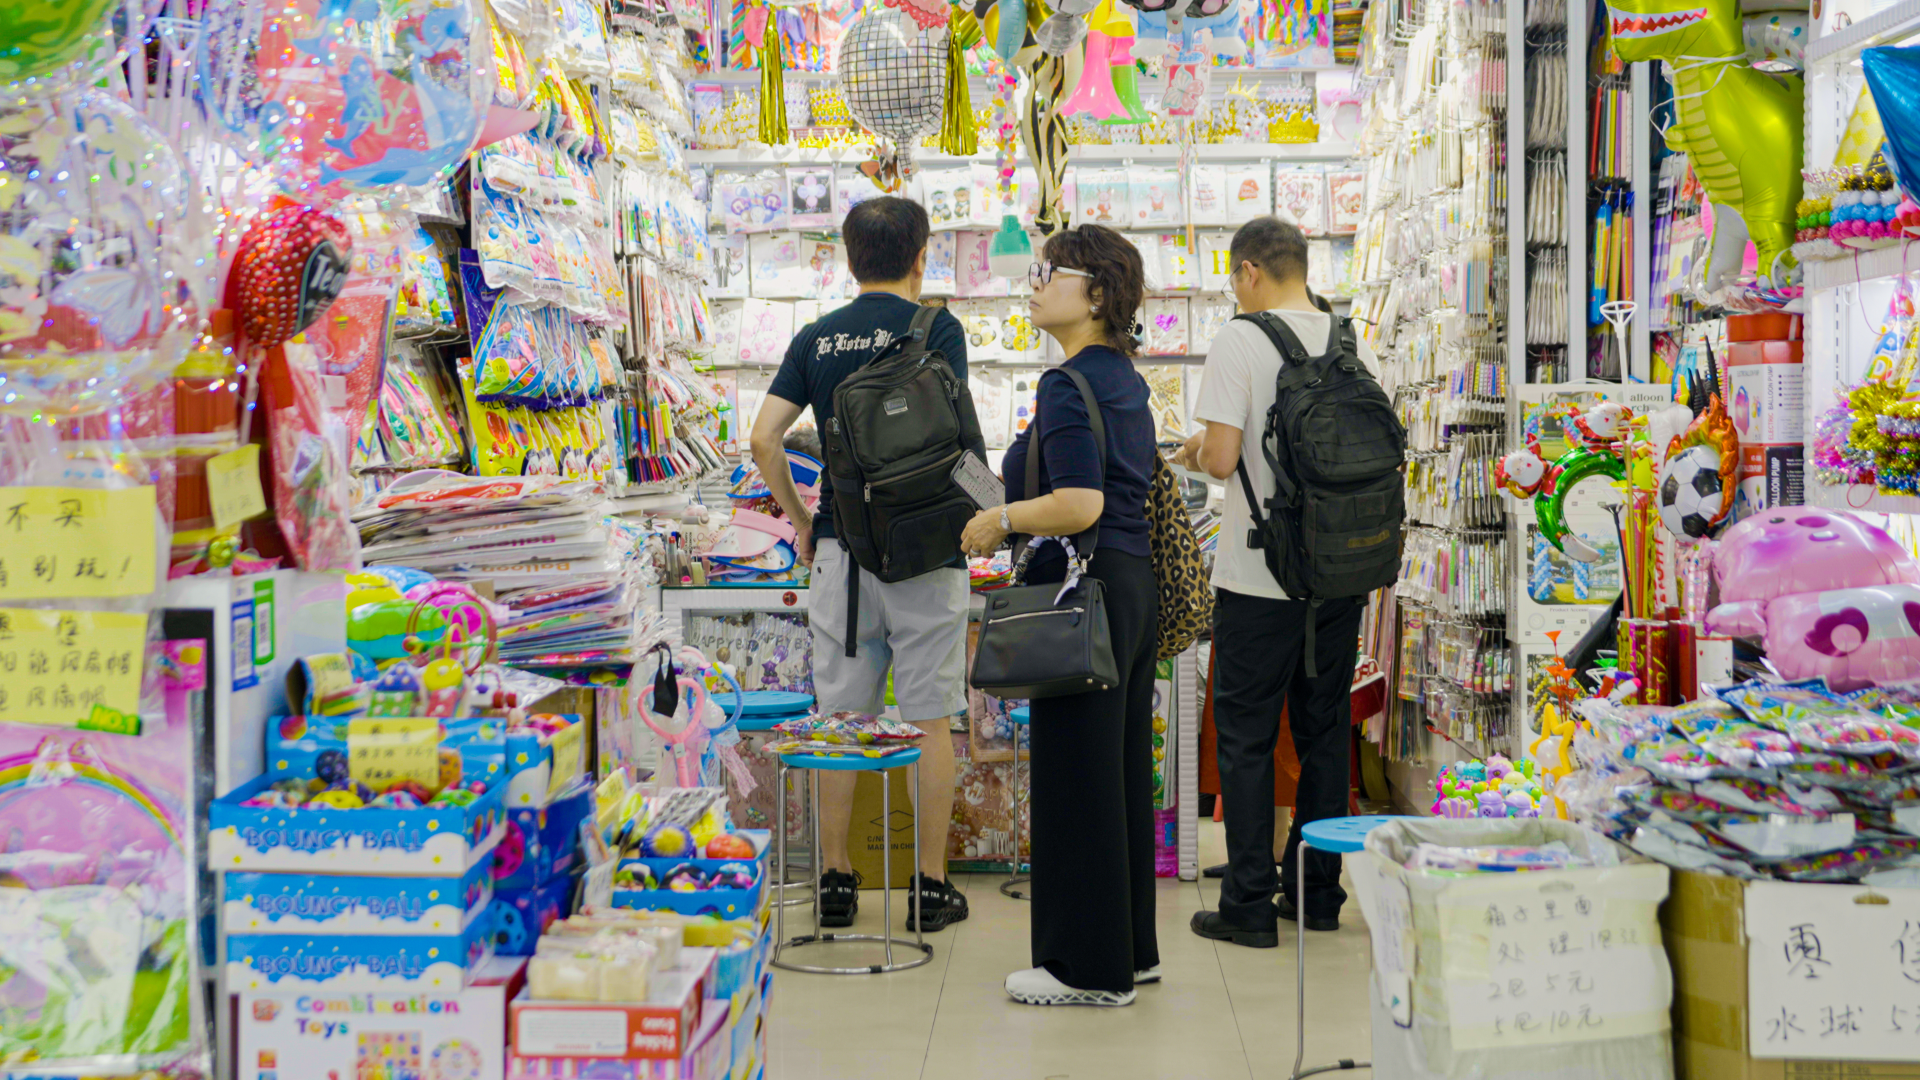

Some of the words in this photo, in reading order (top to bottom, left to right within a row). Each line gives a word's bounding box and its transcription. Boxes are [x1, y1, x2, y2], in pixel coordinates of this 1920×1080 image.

[1629, 393, 1664, 402] alloon
[1770, 456, 1780, 477] PUMP
[6, 498, 83, 532] 不买
[481, 562, 570, 573] Balloon
[245, 828, 353, 850] BOUNCY
[362, 829, 425, 850] BALL
[257, 894, 361, 916] BOUNCY
[367, 895, 426, 916] BALL
[257, 954, 361, 976] BOUNCY
[367, 954, 426, 976] BALL
[295, 993, 460, 1015] Combination
[295, 1017, 350, 1039] Toys
